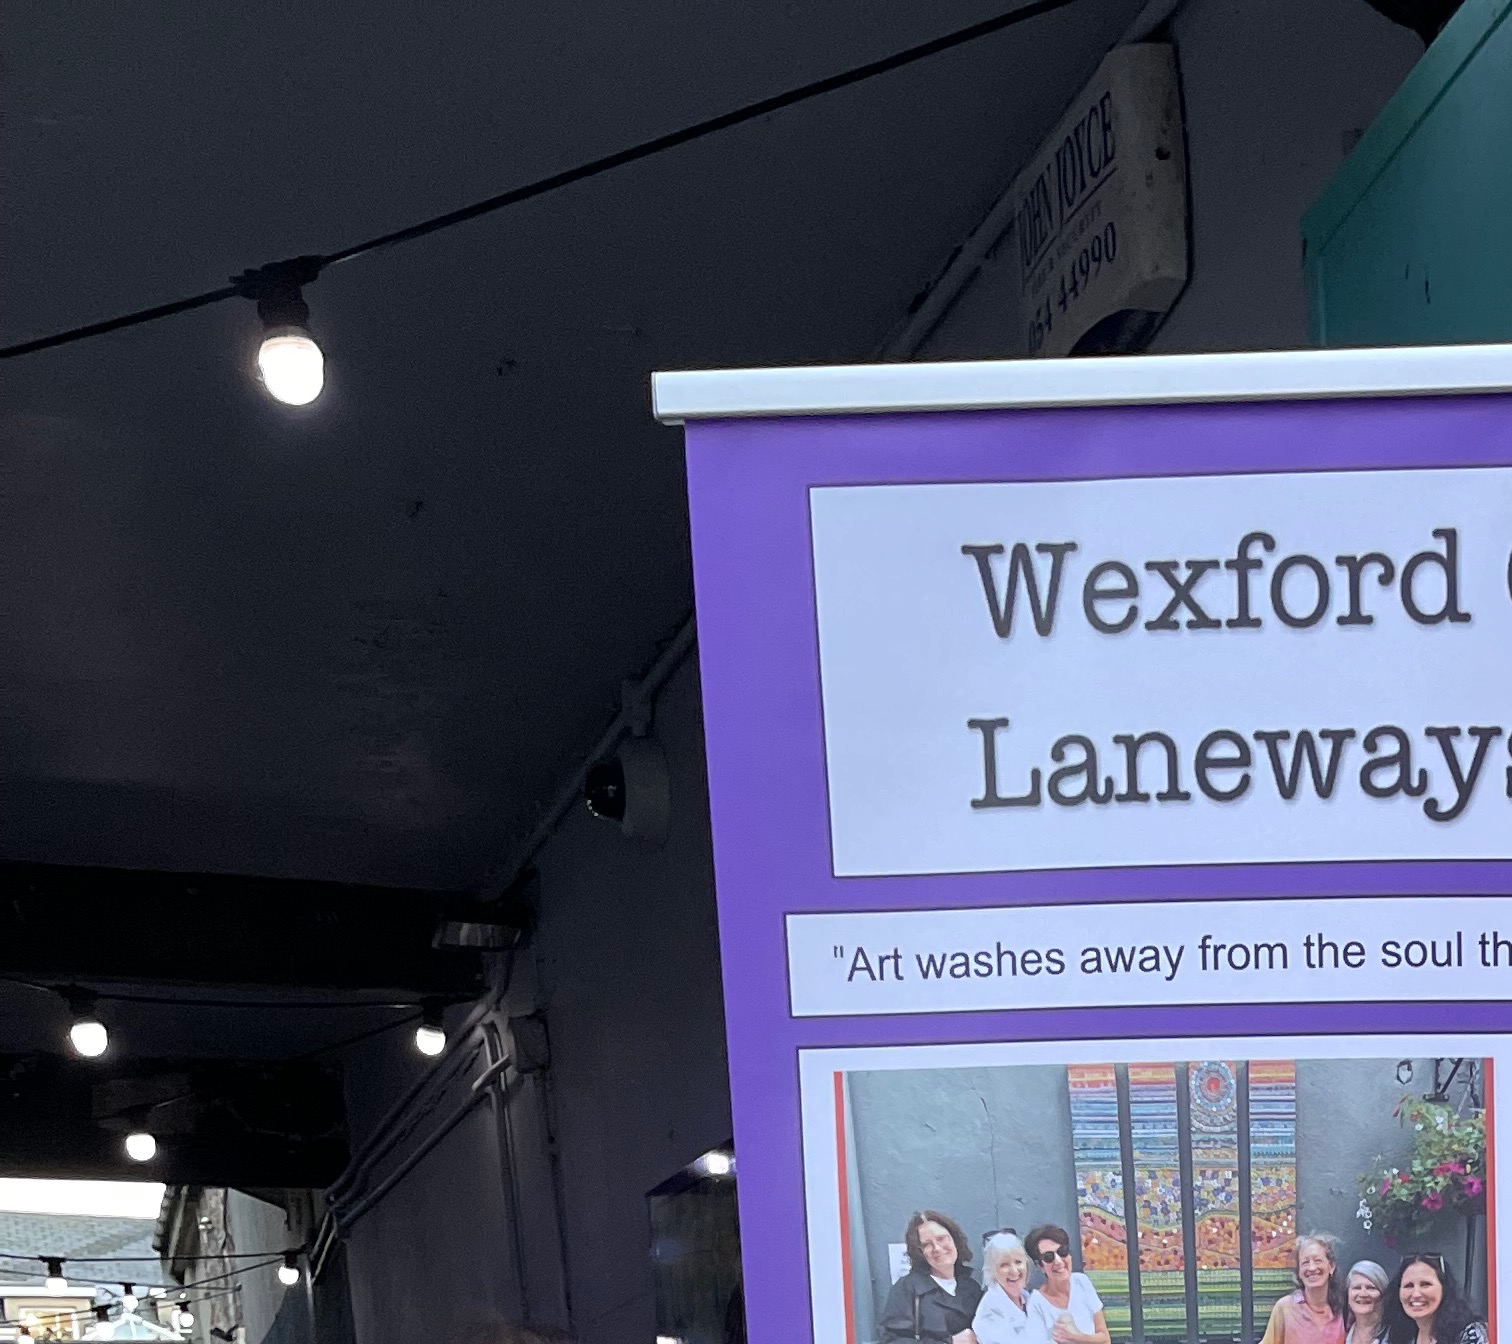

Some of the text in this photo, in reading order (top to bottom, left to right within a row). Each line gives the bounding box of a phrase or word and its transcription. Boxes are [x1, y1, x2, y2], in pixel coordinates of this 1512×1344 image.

[1056, 90, 1116, 230] JOYCE
[1057, 221, 1118, 313] 44990
[961, 528, 1471, 638] Wexford
[832, 944, 904, 982] "Art
[914, 941, 1066, 979] washes
[1080, 940, 1185, 981] away
[1198, 934, 1289, 972] from
[1303, 933, 1367, 969] the
[1380, 931, 1464, 968] soul
